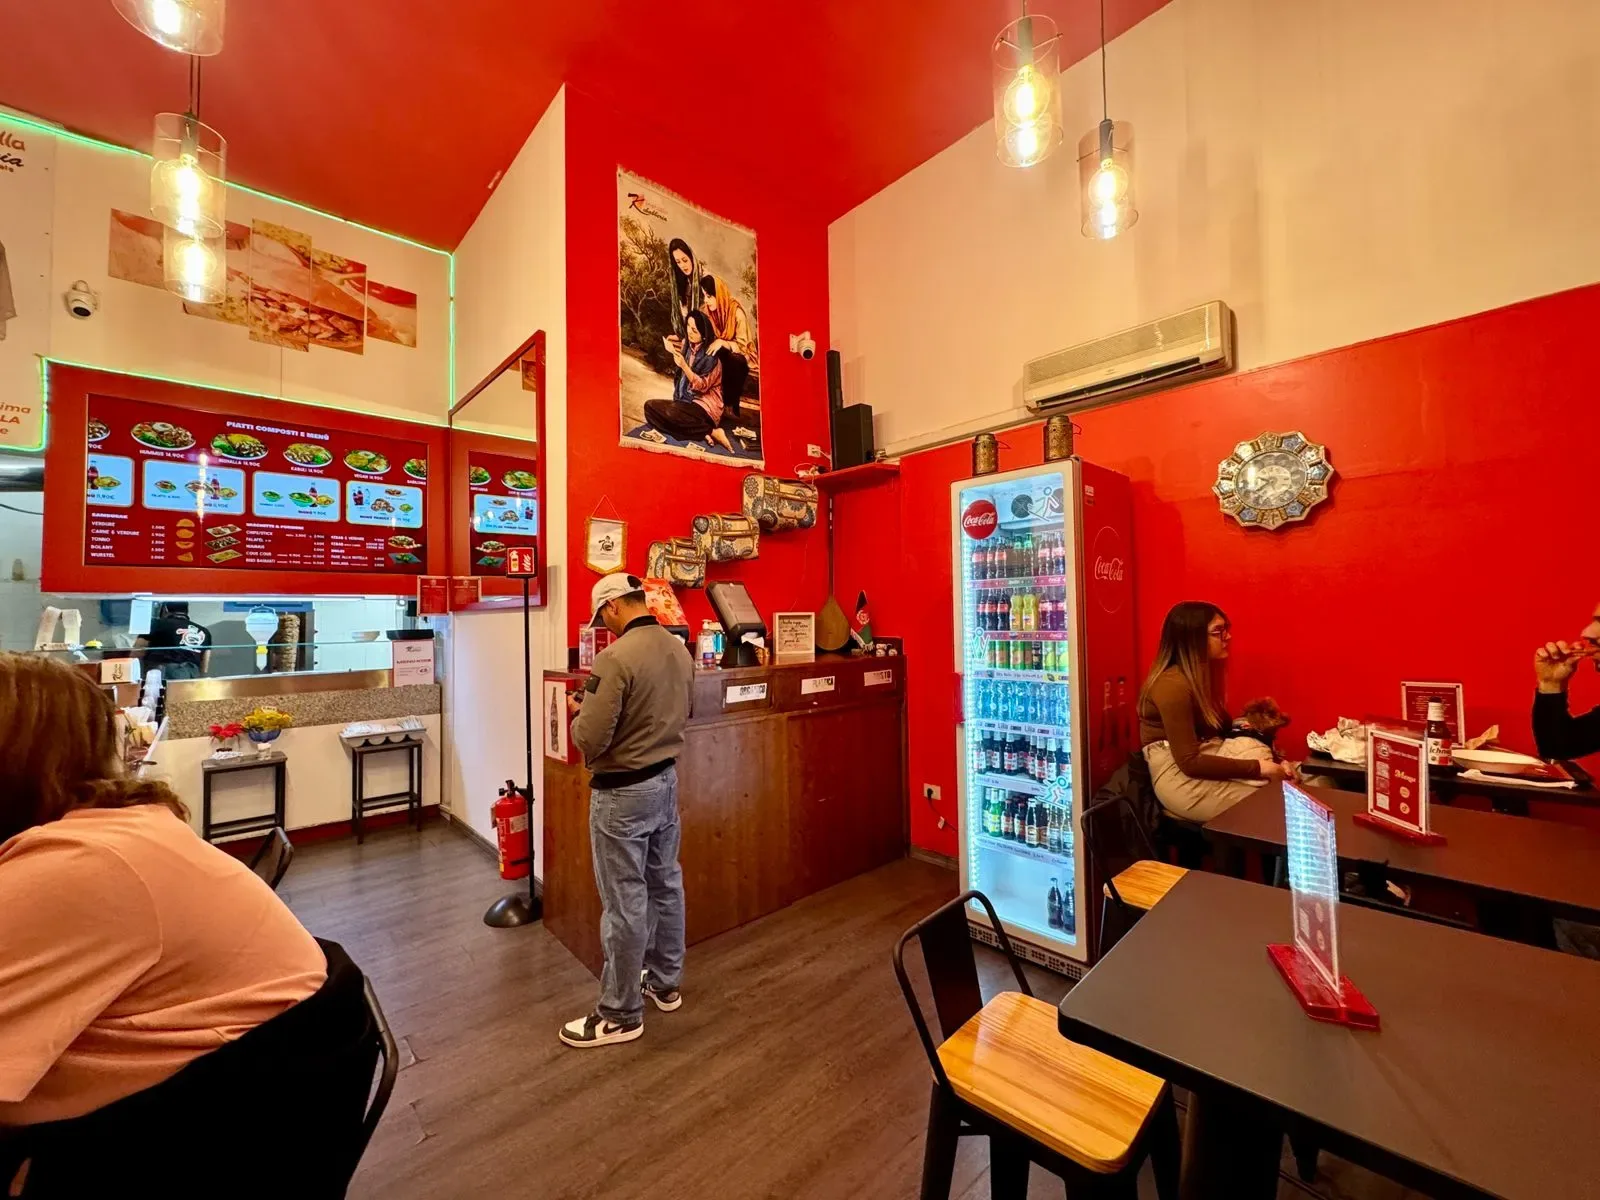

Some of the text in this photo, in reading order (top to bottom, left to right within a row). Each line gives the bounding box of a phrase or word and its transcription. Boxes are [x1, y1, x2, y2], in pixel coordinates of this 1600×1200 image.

[226, 421, 254, 430] PIATTI
[255, 425, 299, 437] COMPOSTI
[139, 449, 164, 457] HUMMUS
[964, 512, 996, 528] Coca-Cola
[1094, 555, 1123, 581] Coca-Cola
[739, 684, 765, 696] ORGCO
